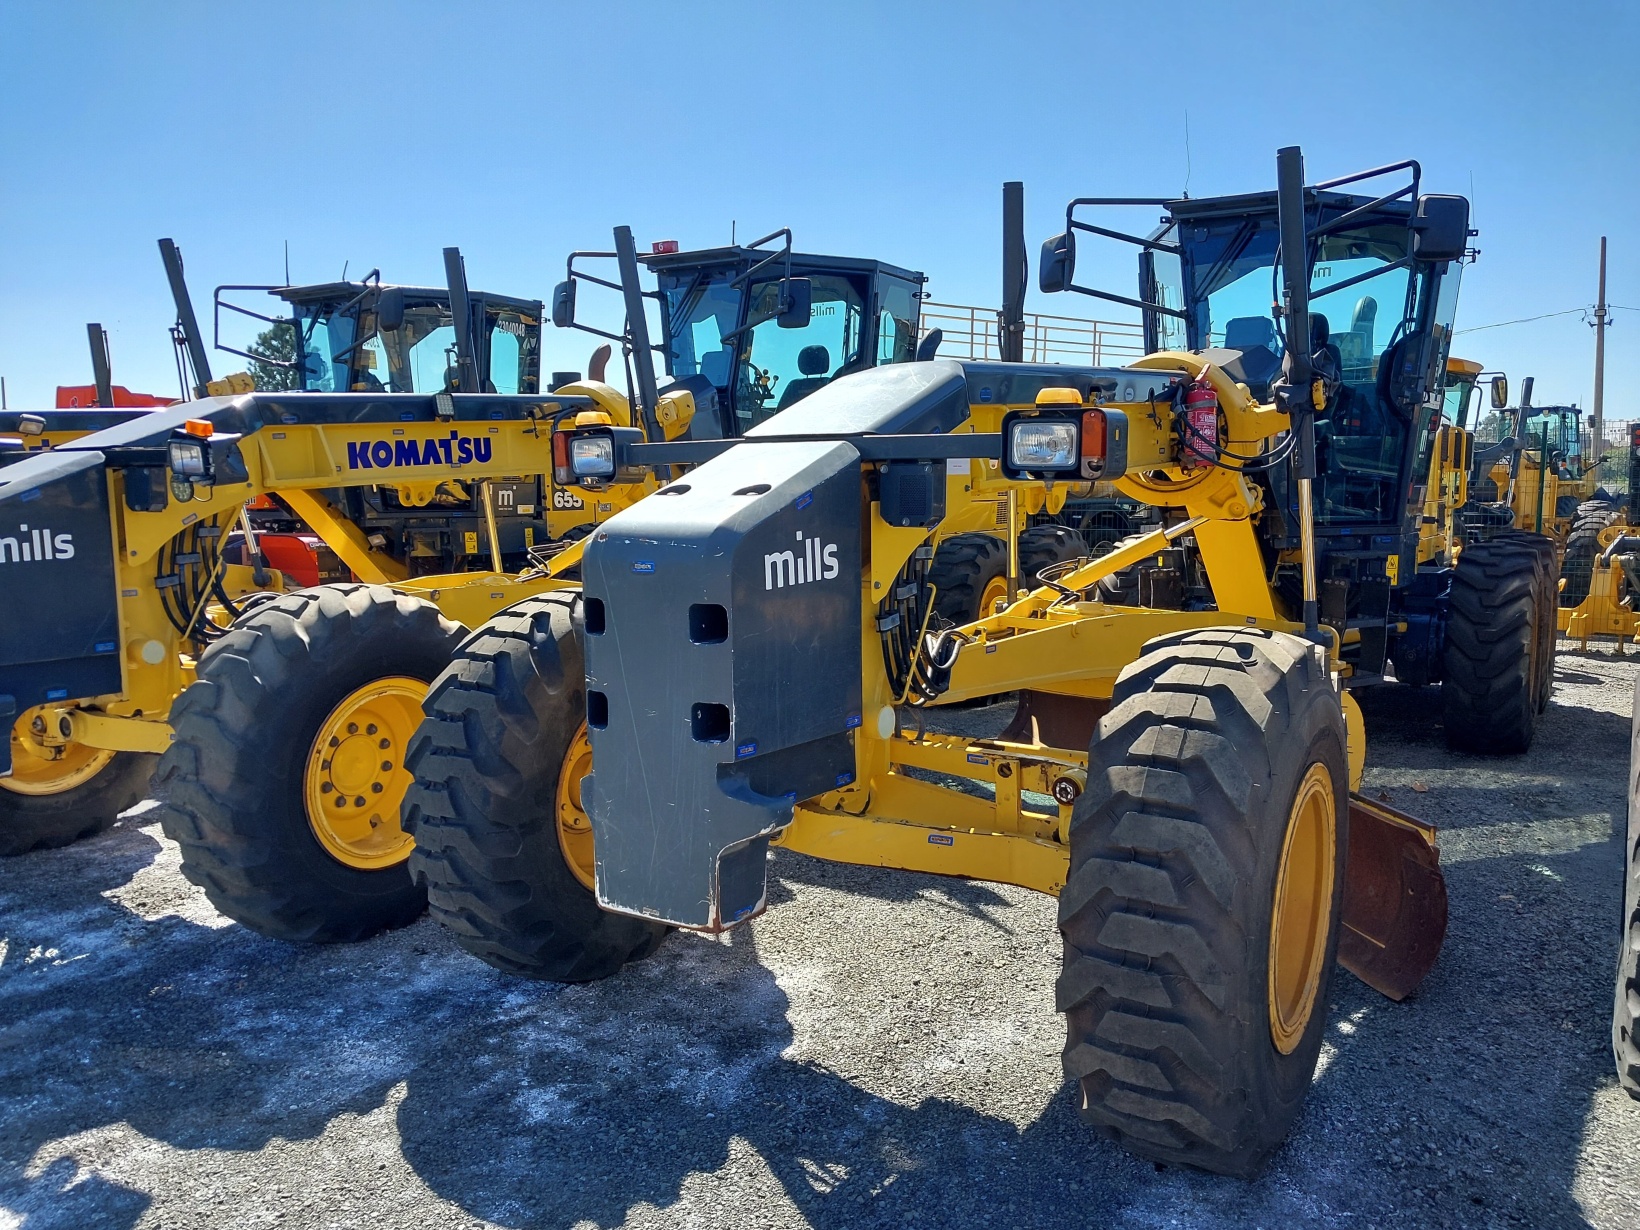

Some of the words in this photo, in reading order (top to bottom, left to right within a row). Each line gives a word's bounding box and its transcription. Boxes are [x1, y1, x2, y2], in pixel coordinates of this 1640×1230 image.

[347, 430, 492, 469] KOMATSU
[553, 491, 583, 508] 655
[764, 530, 839, 591] mills
